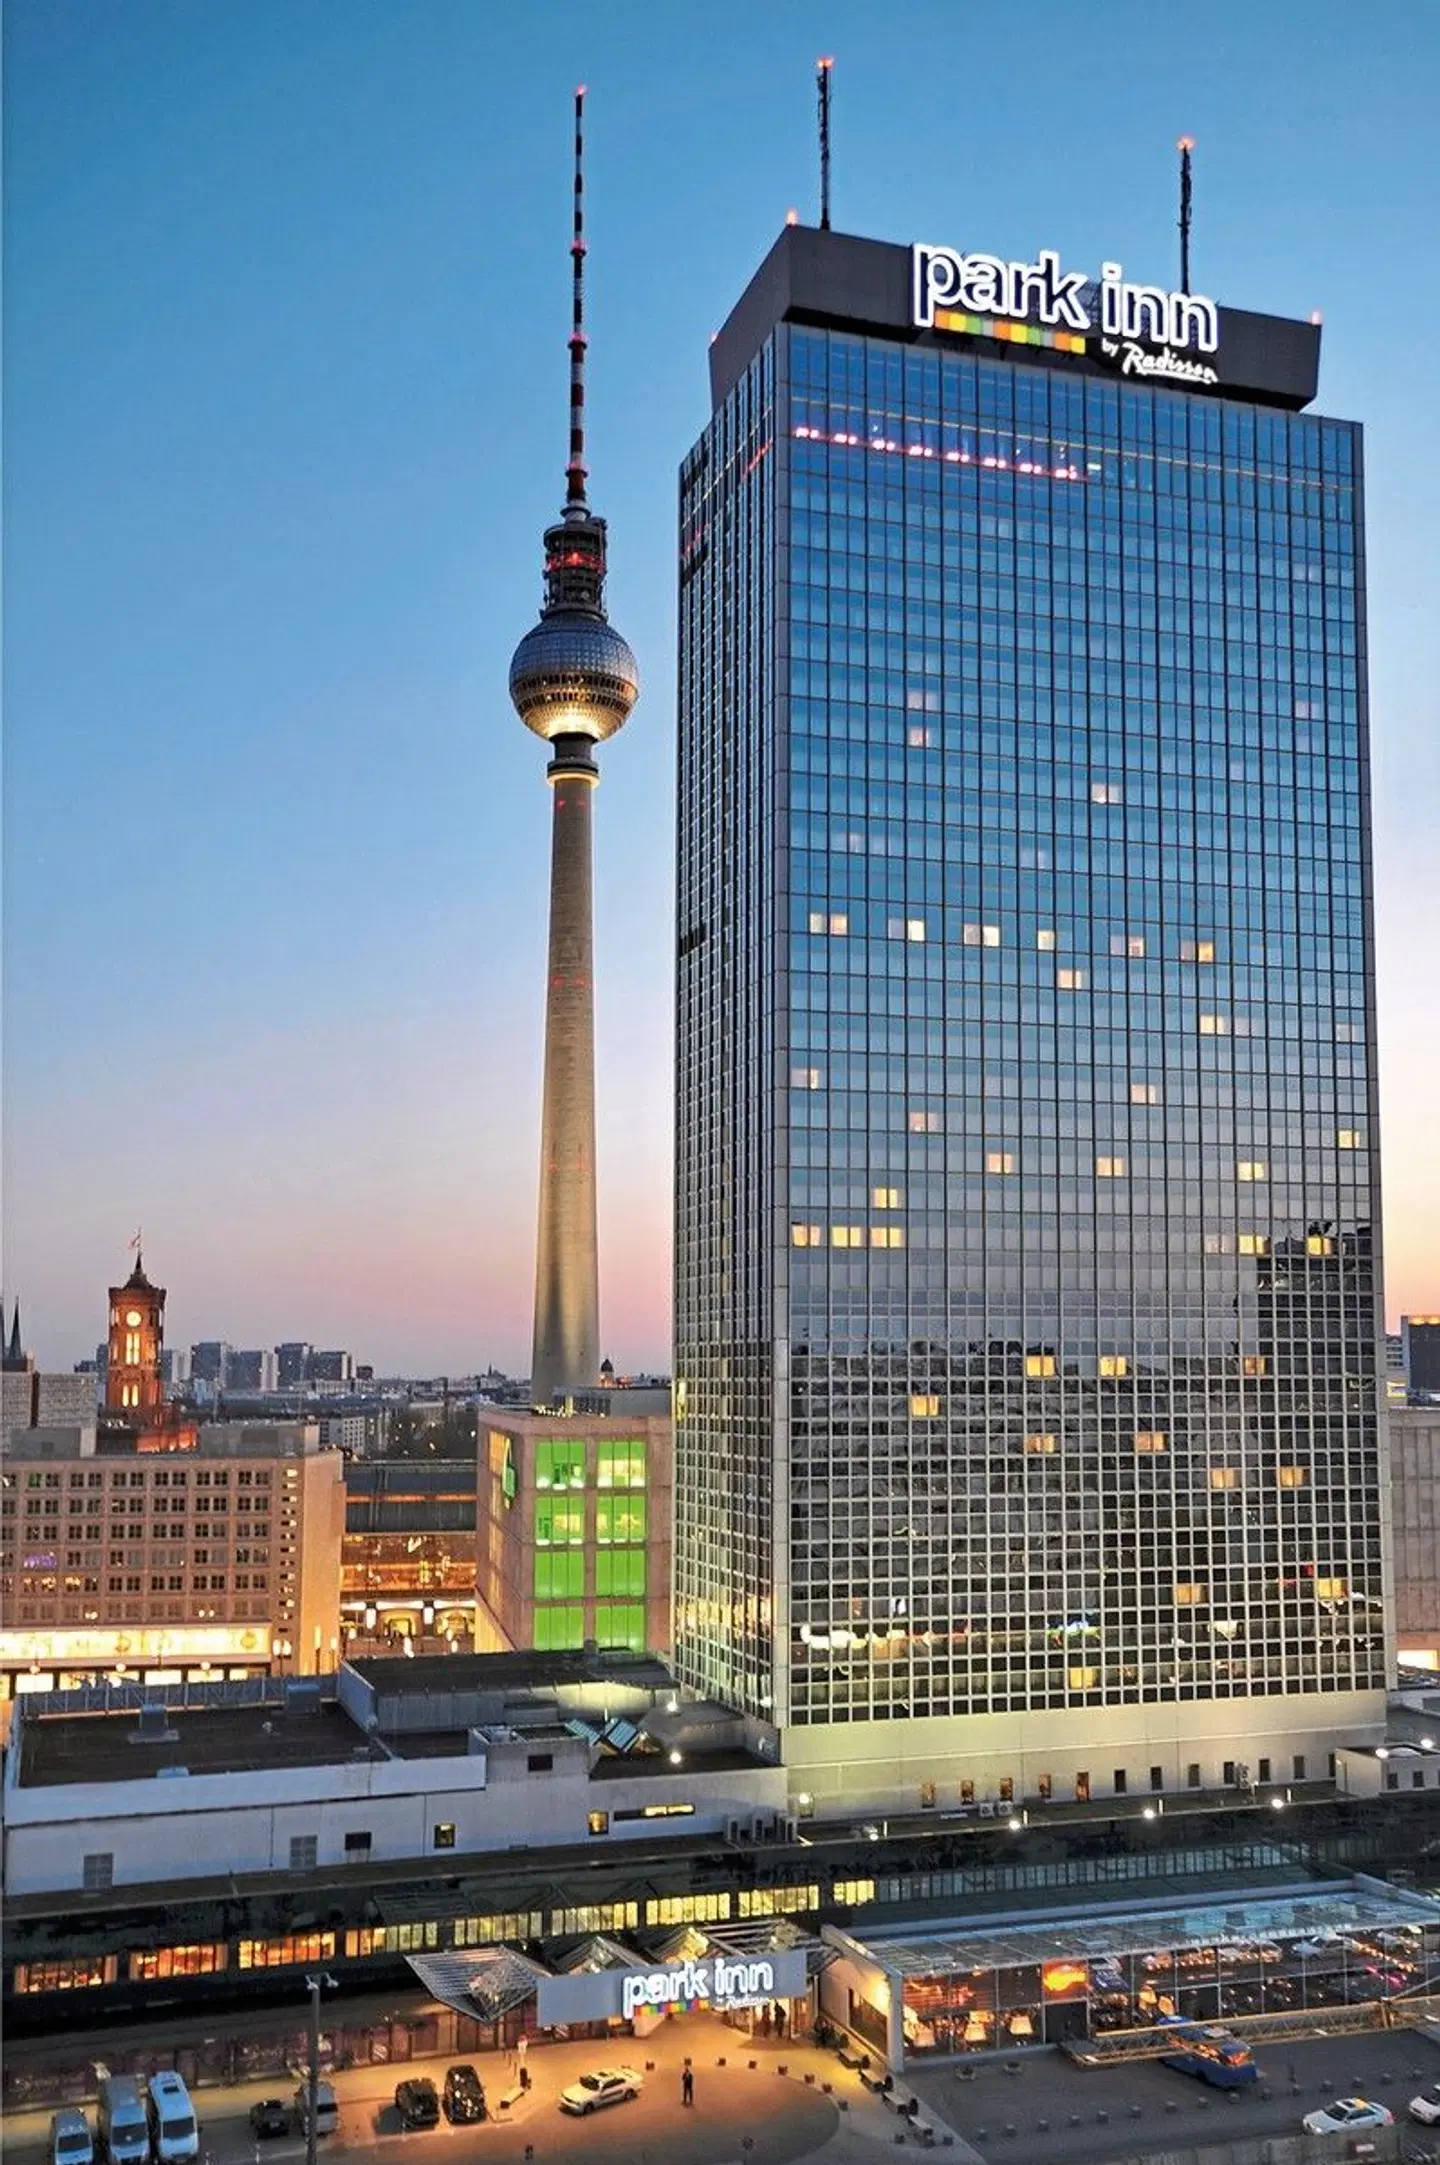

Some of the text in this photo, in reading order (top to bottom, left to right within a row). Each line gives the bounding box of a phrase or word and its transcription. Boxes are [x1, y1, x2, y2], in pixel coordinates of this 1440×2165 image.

[913, 243, 1219, 353] park inn
[1101, 337, 1218, 384] by Radisson
[623, 1958, 773, 2019] park inn
